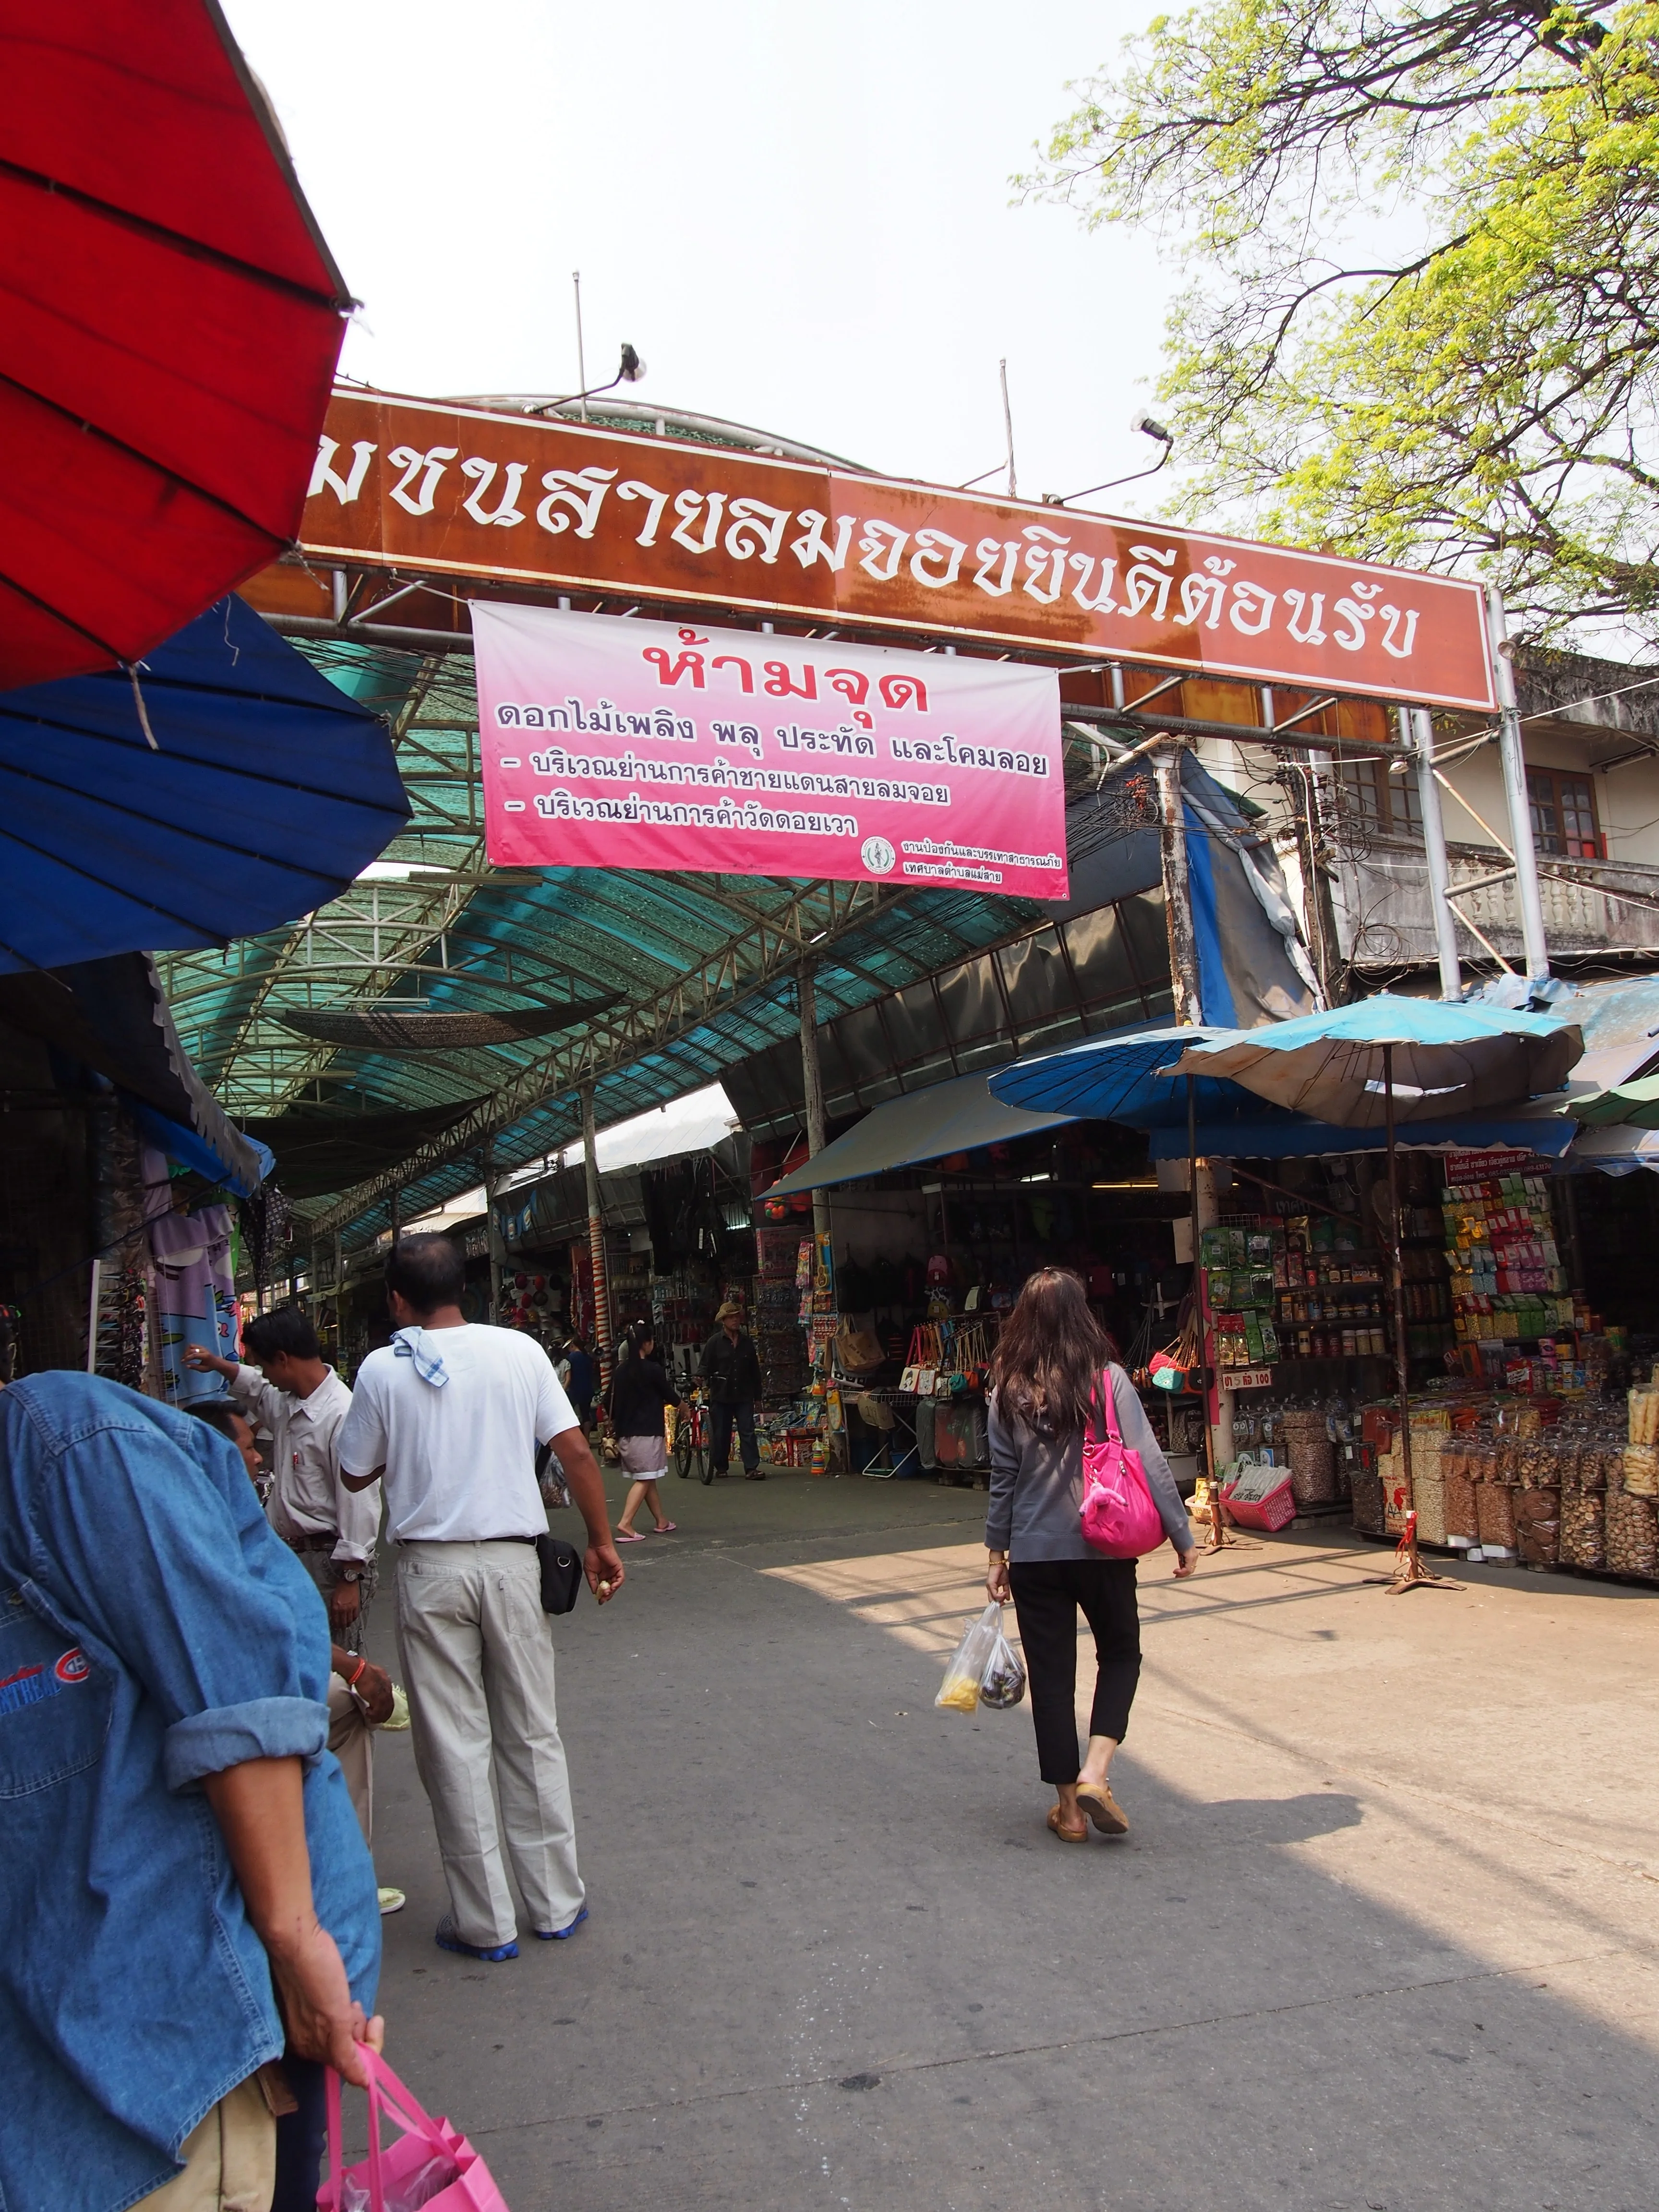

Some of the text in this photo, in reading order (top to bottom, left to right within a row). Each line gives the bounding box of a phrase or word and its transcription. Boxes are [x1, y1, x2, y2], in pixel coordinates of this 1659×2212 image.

[642, 628, 929, 729] ห้ามจุด
[498, 699, 1048, 776] ดอกไม้เพลิง พลุ ประทัด และโคมลอย
[532, 751, 949, 805] บริเวณย่านการค้าชายแดนสายลมจอย
[538, 792, 857, 836] บริเวณย่านการค้าวัดดอยเวา
[903, 840, 1060, 867] งานป้องกันและบรรเทาสาธารณภัย
[905, 864, 1001, 882] เทศบาลตำบลแม่สาย
[1234, 1376, 1241, 1386] 5
[1255, 1373, 1269, 1384] 100
